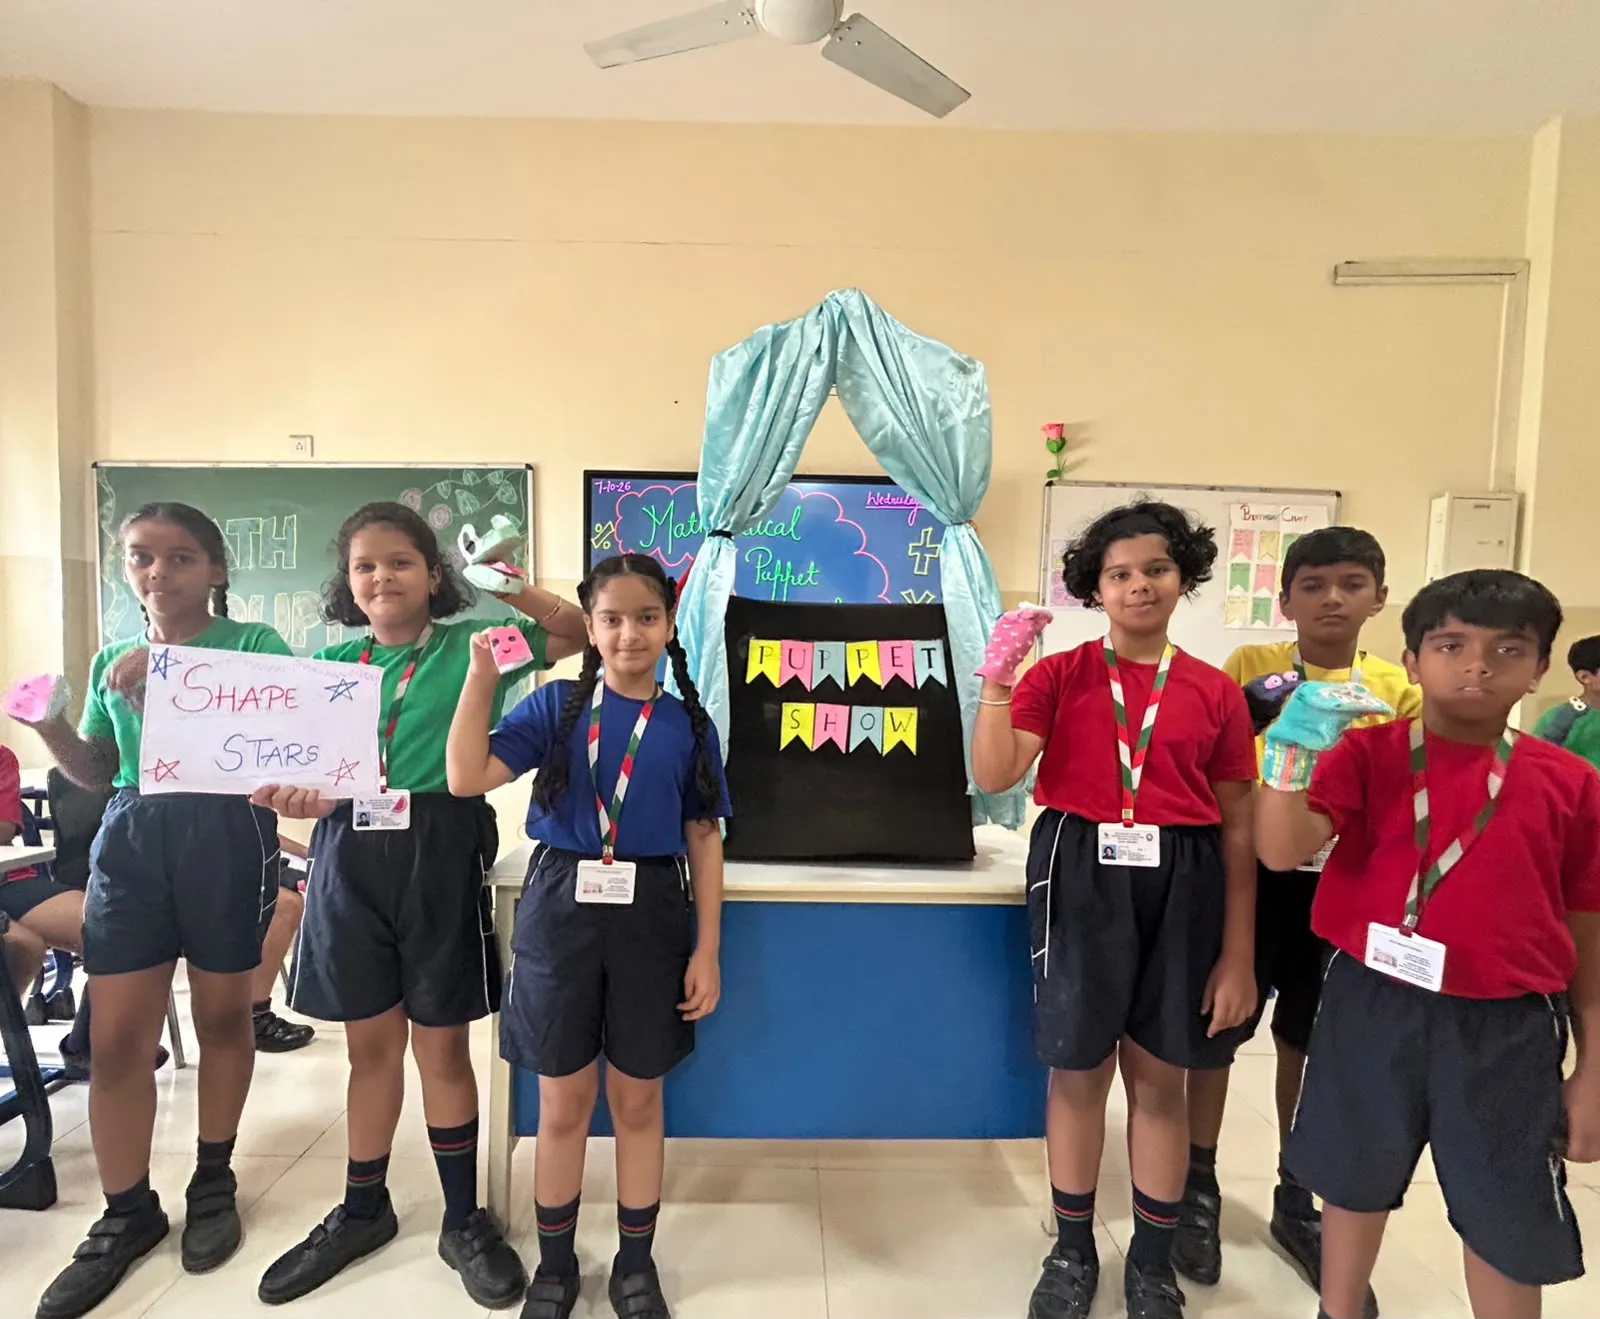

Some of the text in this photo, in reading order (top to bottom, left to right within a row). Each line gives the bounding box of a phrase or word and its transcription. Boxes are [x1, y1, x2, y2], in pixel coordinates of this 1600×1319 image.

[745, 546, 819, 602] Puppet
[758, 645, 937, 671] PUPPET
[172, 662, 299, 713] SHAPE
[789, 708, 914, 733] SHOW
